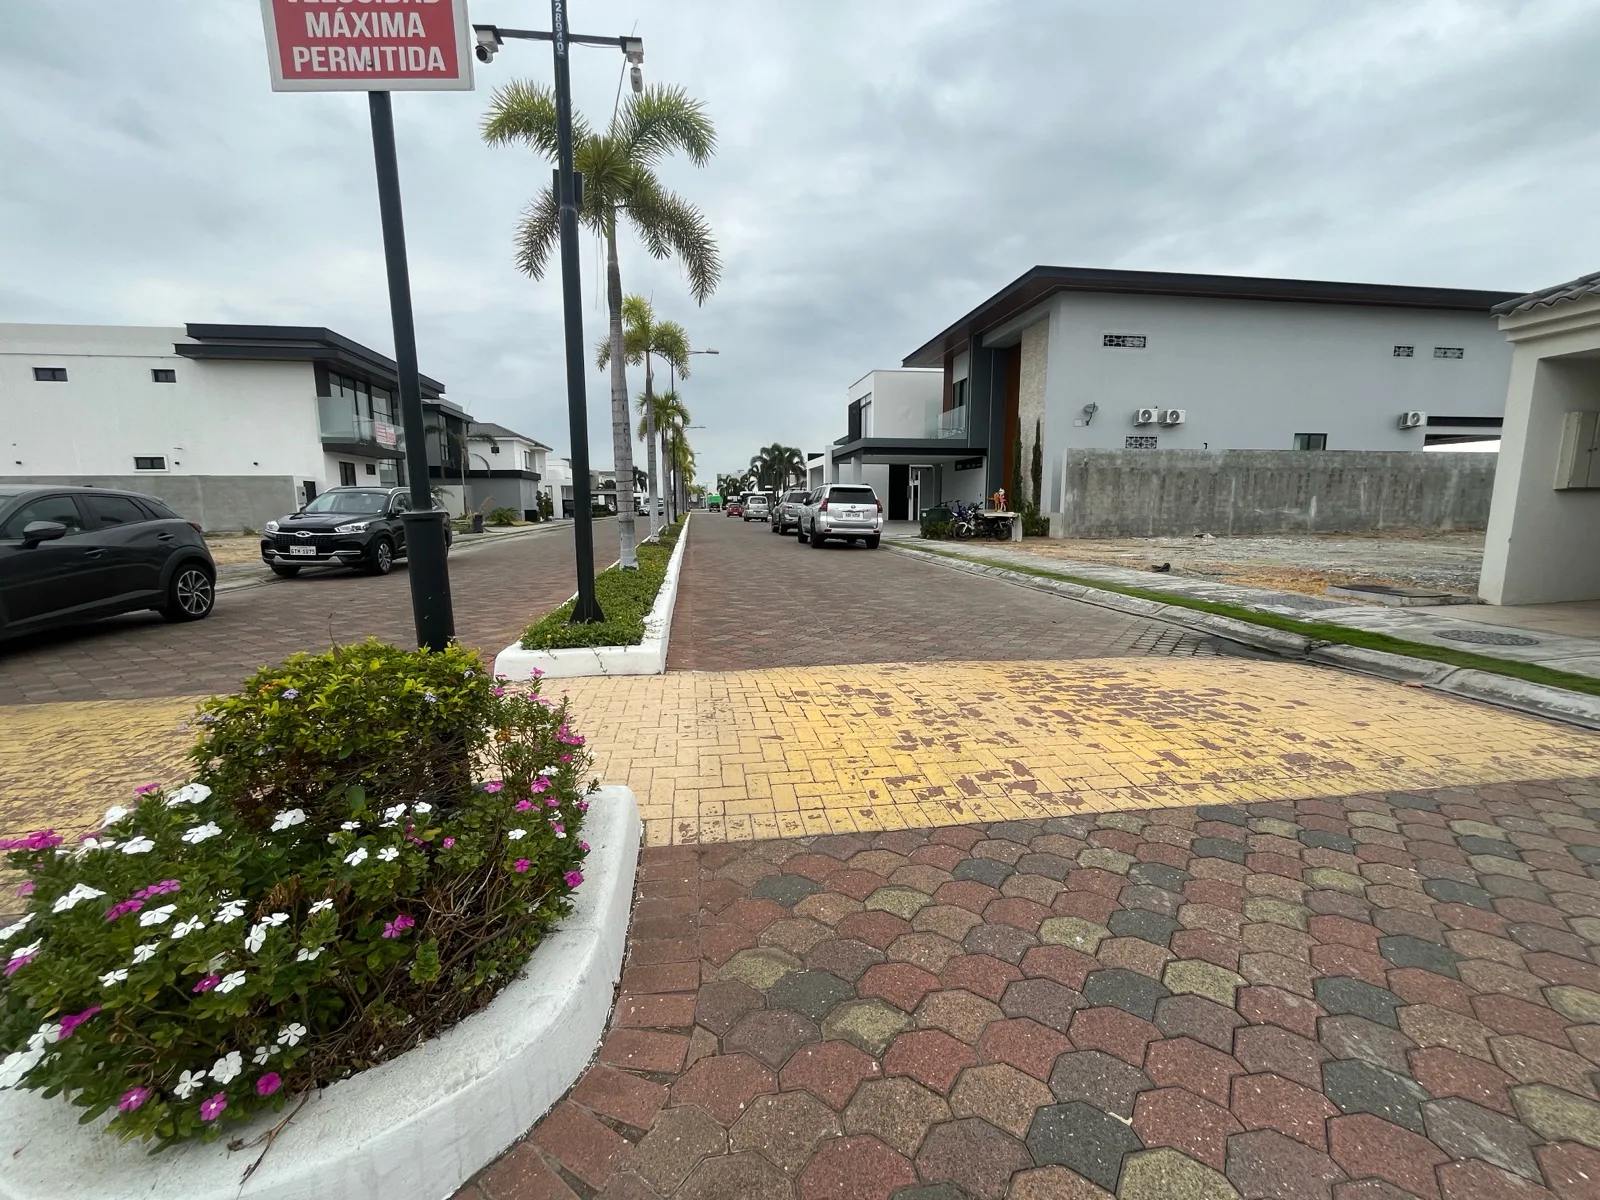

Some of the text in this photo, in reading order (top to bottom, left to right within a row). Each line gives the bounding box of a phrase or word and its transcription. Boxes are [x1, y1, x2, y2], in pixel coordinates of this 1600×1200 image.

[305, 7, 426, 38] MÁXIMA
[555, 0, 564, 51] 28940
[292, 46, 446, 72] PERMITIDA
